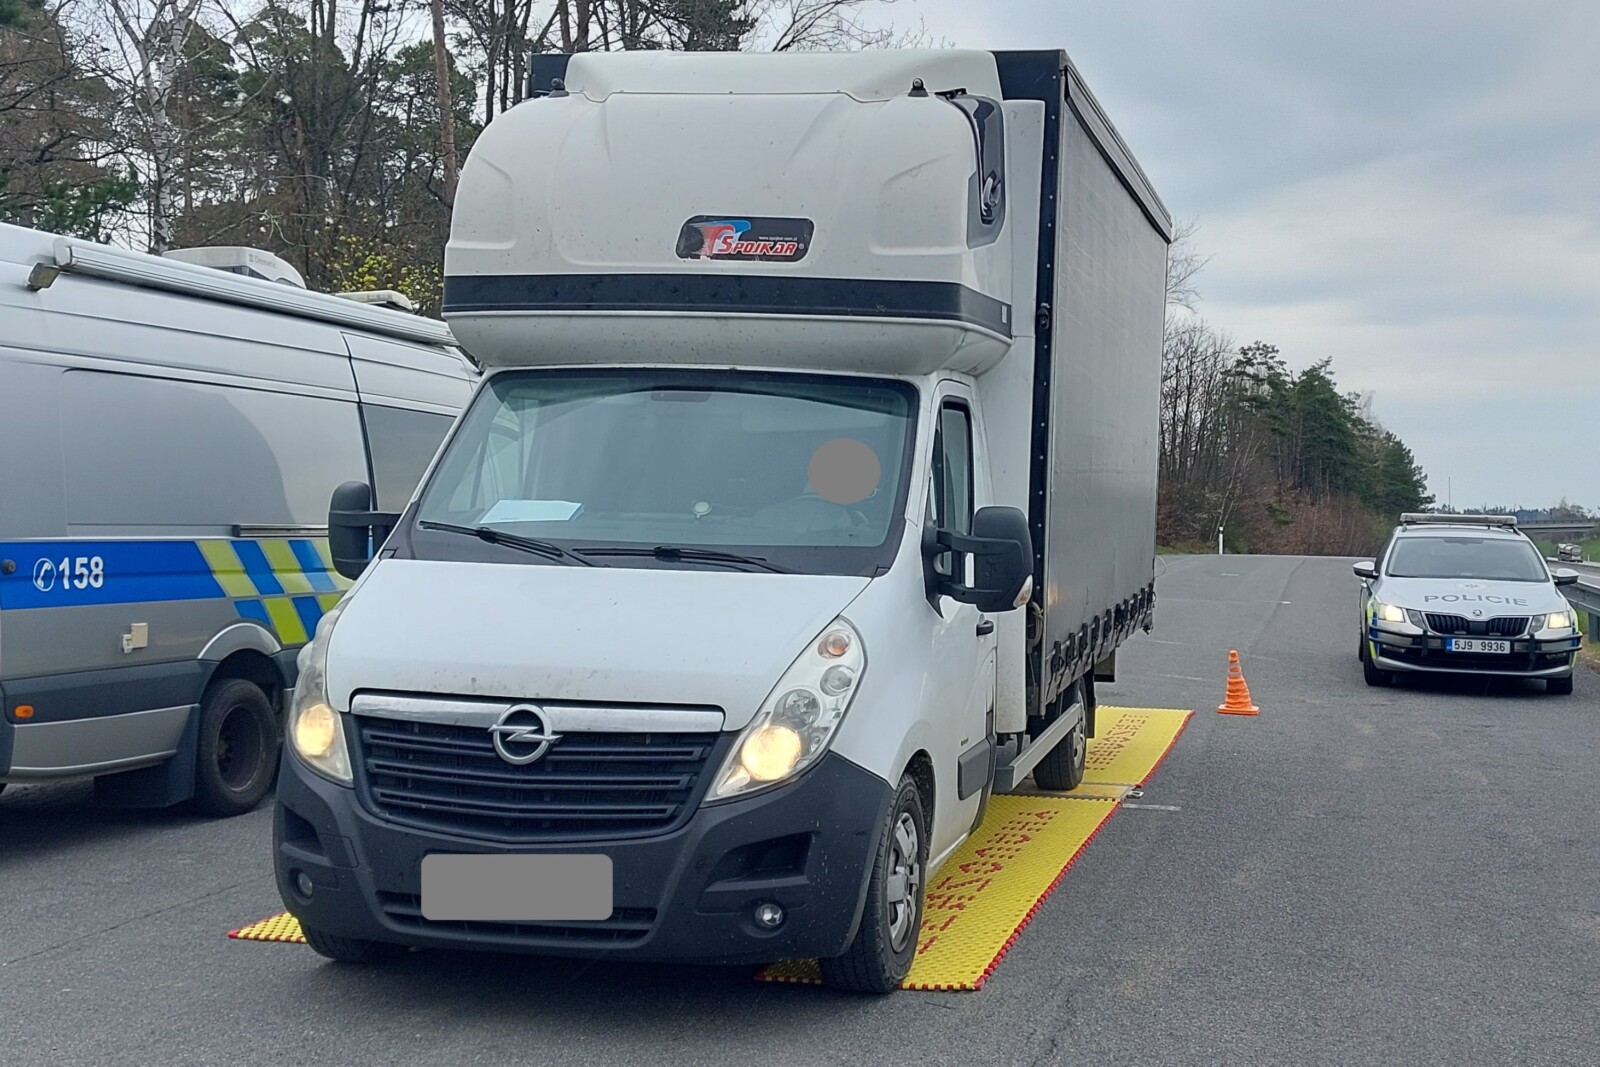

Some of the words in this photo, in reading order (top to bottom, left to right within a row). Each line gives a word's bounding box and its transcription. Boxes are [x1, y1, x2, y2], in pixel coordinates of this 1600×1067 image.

[58, 556, 104, 590] 158
[1424, 594, 1529, 607] POLICIE
[1454, 640, 1473, 651] 5J9
[1480, 641, 1506, 652] 9936
